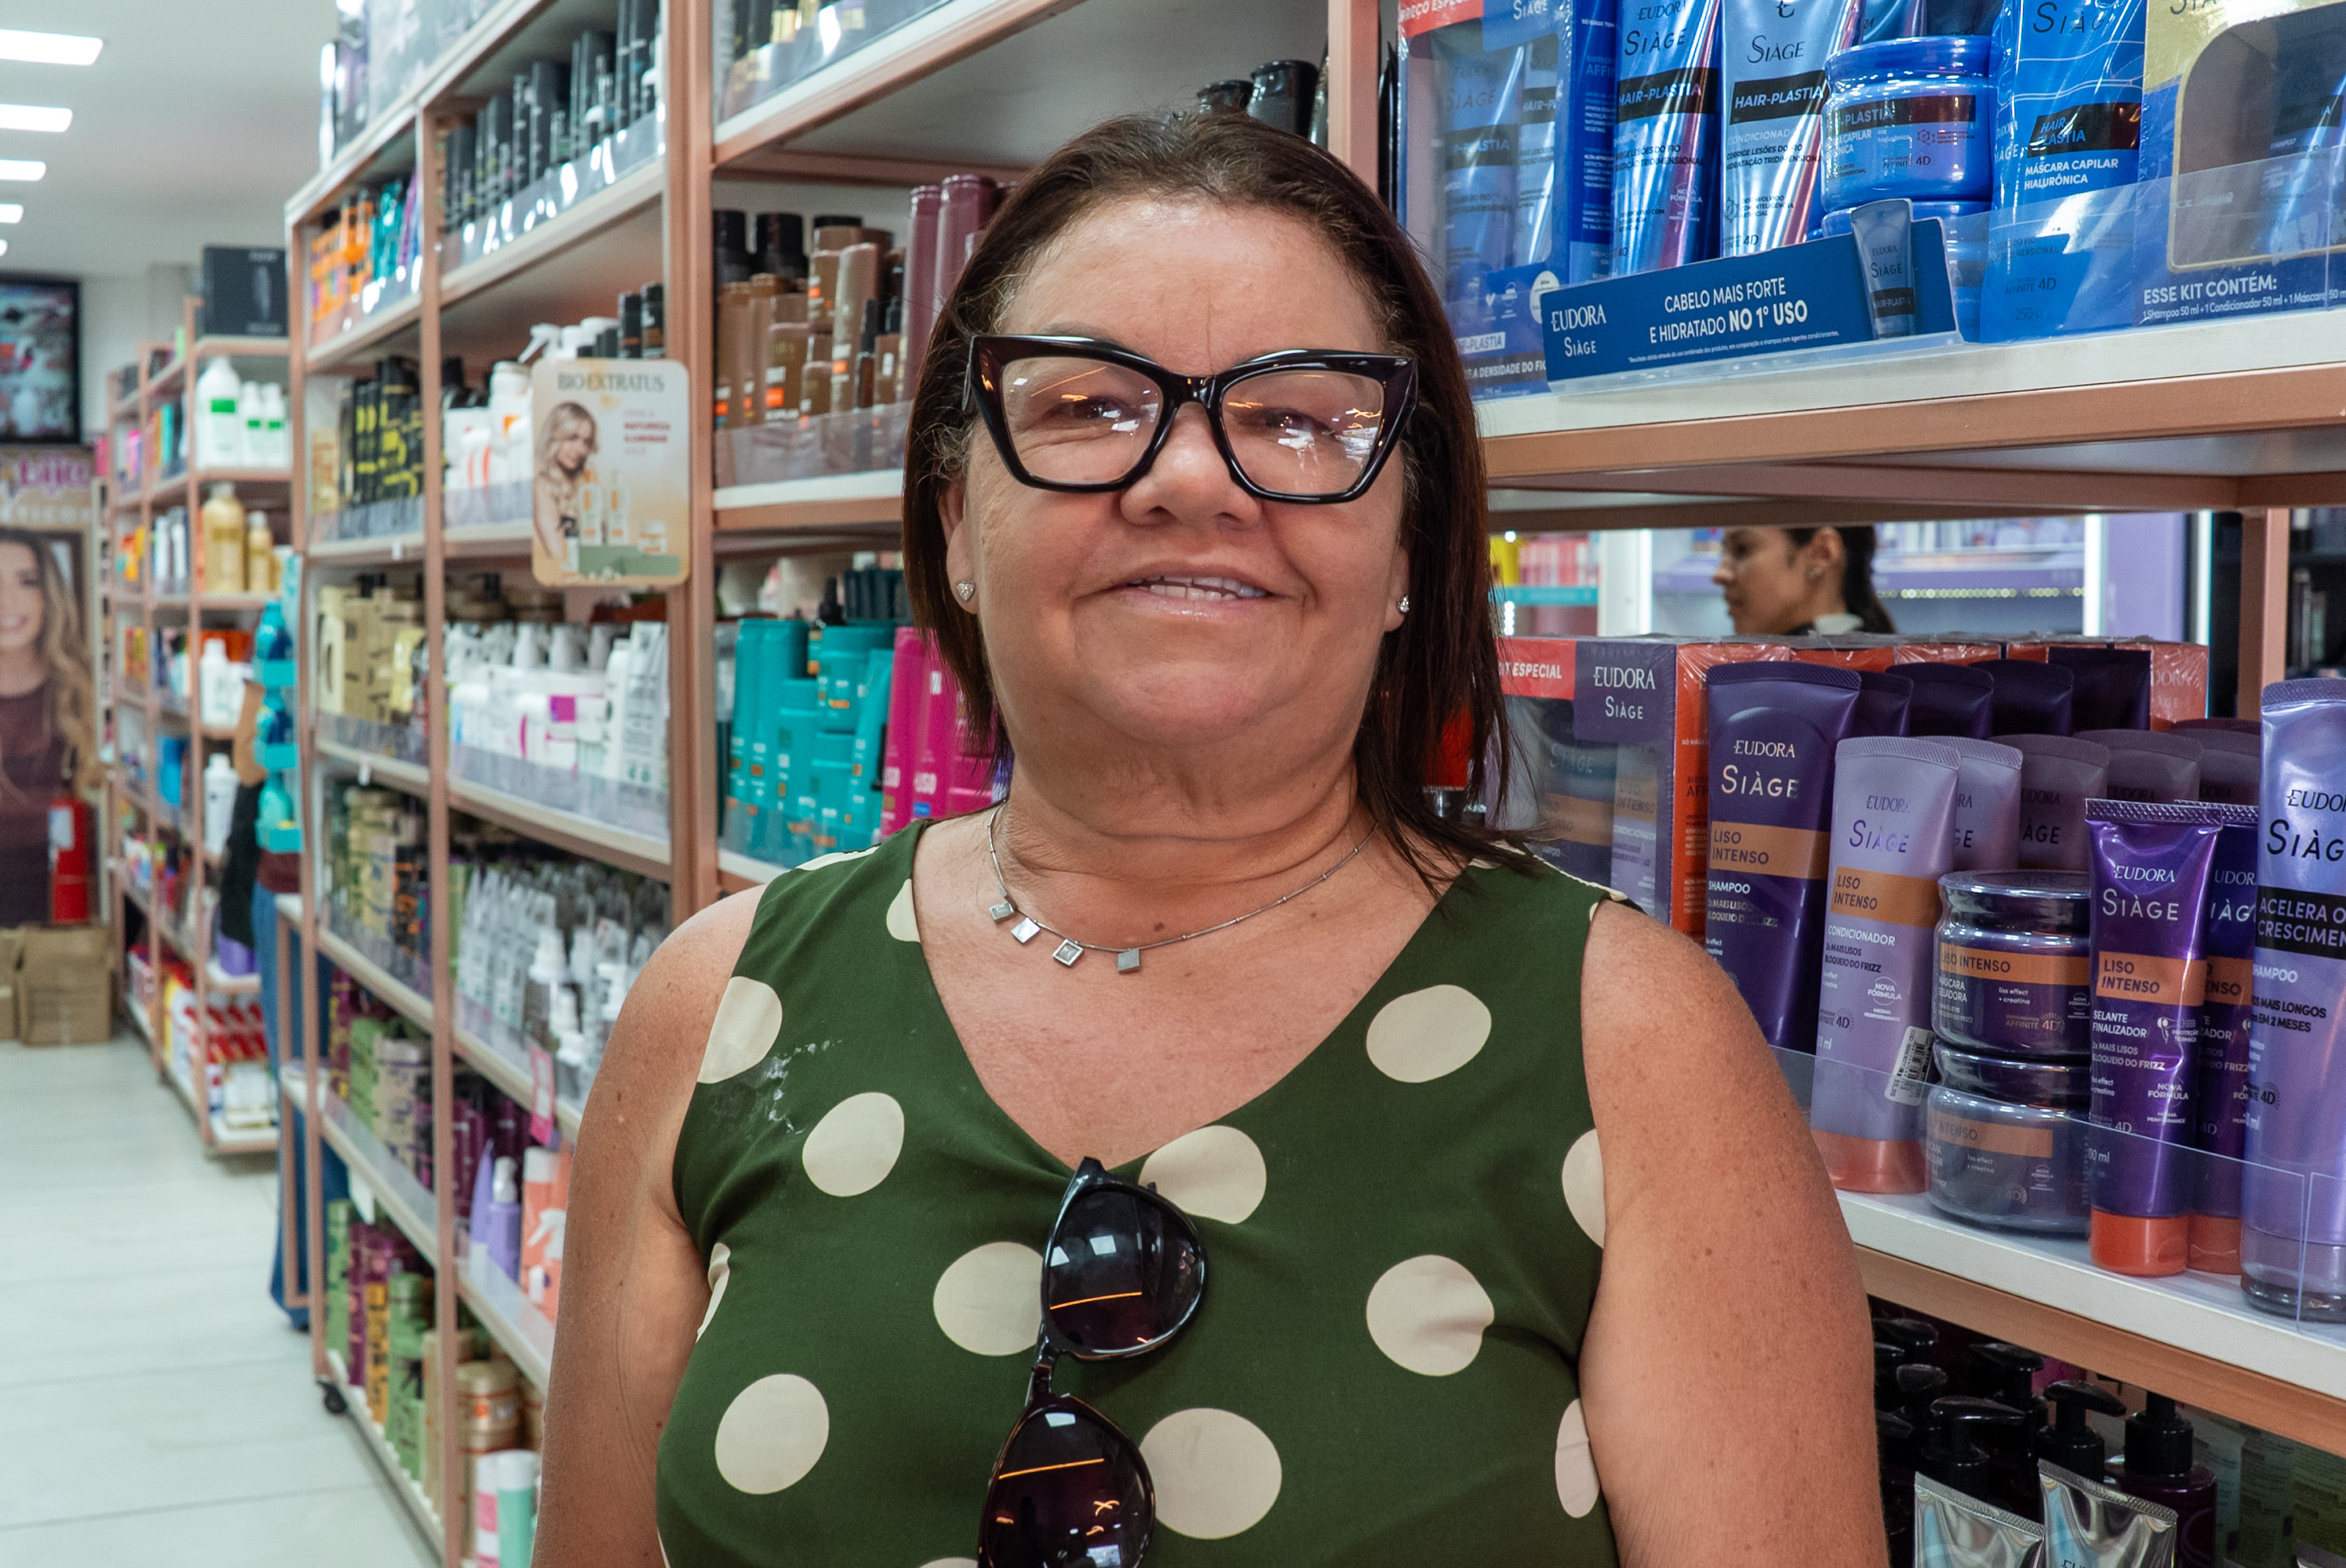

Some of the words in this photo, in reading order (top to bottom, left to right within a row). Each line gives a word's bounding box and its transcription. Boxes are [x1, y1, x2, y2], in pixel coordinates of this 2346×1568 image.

[1625, 29, 1686, 56] SIÀGE
[1747, 35, 1806, 63] SIÀGE
[1618, 82, 1702, 105] HAIR-PLASTIA
[1734, 85, 1824, 109] HAIR-PLASTIA
[1843, 129, 1872, 143] CAPILAR
[1752, 144, 1777, 155] LESÕES
[1915, 155, 1932, 166] 4D
[2025, 161, 2069, 176] MÁSCARA
[2071, 158, 2119, 171] CAPILAR
[2024, 174, 2089, 190] HIALURÔNICA
[1871, 262, 1903, 278] SIÀGE
[2038, 276, 2057, 290] 4D
[2144, 286, 2177, 304] ESSE
[2180, 283, 2203, 301] KIT
[2205, 271, 2277, 297] CONTÉM:
[1664, 289, 1710, 313] CABELO
[1712, 284, 1744, 306] MAIS
[1746, 276, 1787, 300] FORTE
[2147, 308, 2179, 320] Shampoo
[2180, 305, 2190, 316] 50
[2190, 304, 2199, 314] ml
[2205, 304, 2209, 313] 1
[2210, 297, 2262, 312] Condicionador
[2262, 296, 2273, 307] 50
[2273, 295, 2283, 305] ml
[2293, 290, 2327, 304] Máscara
[2328, 288, 2339, 299] 50
[1552, 304, 1607, 332] EUDORA
[1650, 327, 1658, 343] E
[1659, 316, 1726, 343] HIDRATADO
[1728, 308, 1753, 332] NO
[1772, 299, 1808, 326] USO
[1563, 335, 1597, 357] SIÀGE
[1479, 363, 1520, 378] DENSIDADE
[1521, 361, 1534, 372] DO
[1512, 662, 1562, 679] ESPECIAL
[1593, 666, 1656, 690] EUDORA
[1605, 696, 1643, 719] SIÀGE
[1733, 739, 1796, 758] EUDORA
[1721, 764, 1799, 799] SIÀGE
[1865, 795, 1911, 813] EUDORA
[1712, 829, 1742, 845] LISO
[1850, 819, 1909, 853] SIÀGE
[1712, 847, 1770, 864] INTENSO
[1837, 875, 1861, 890] LISO
[2113, 865, 2175, 883] EUDORA
[1708, 880, 1751, 894] SHAMPOO
[1834, 892, 1878, 911] INTENSO
[2102, 888, 2179, 921] SIÀGE
[2259, 897, 2328, 922] ACELERA
[2333, 907, 2346, 924] O
[1827, 925, 1896, 947] CONDICIONADOR
[1831, 943, 1844, 954] MAIS
[1844, 946, 1862, 956] LISOS
[1850, 958, 1860, 969] DO
[1860, 962, 1882, 973] FRIZZ
[1960, 956, 2011, 973] INTENSO
[2104, 959, 2135, 974] LISO
[2253, 963, 2298, 983] HAMPOO
[1874, 982, 1896, 992] NOVA
[2010, 987, 2029, 996] effect
[2101, 975, 2160, 994] INTENSO
[1867, 989, 1902, 1001] FÓRMULA
[2093, 1009, 2128, 1023] SELANTE
[2260, 997, 2281, 1011] MAIS
[2281, 1001, 2327, 1018] LONGOS
[1836, 1016, 1850, 1029] 4D
[2093, 1022, 2148, 1038] FINALIZADOR
[2258, 1013, 2270, 1025] EM
[2270, 1016, 2277, 1026] 2
[2277, 1017, 2311, 1033] MESES
[2098, 1042, 2116, 1053] MAIS
[2116, 1045, 2139, 1055] LISOS
[2092, 1053, 2123, 1065] BLOQUEIO
[2124, 1058, 2138, 1068] DO
[2139, 1060, 2166, 1071] FRIZZ
[2148, 1089, 2189, 1100] FÓRMULA
[2260, 1089, 2276, 1105] 4D
[2115, 1122, 2132, 1133] 4D
[2098, 1151, 2110, 1163] ml
